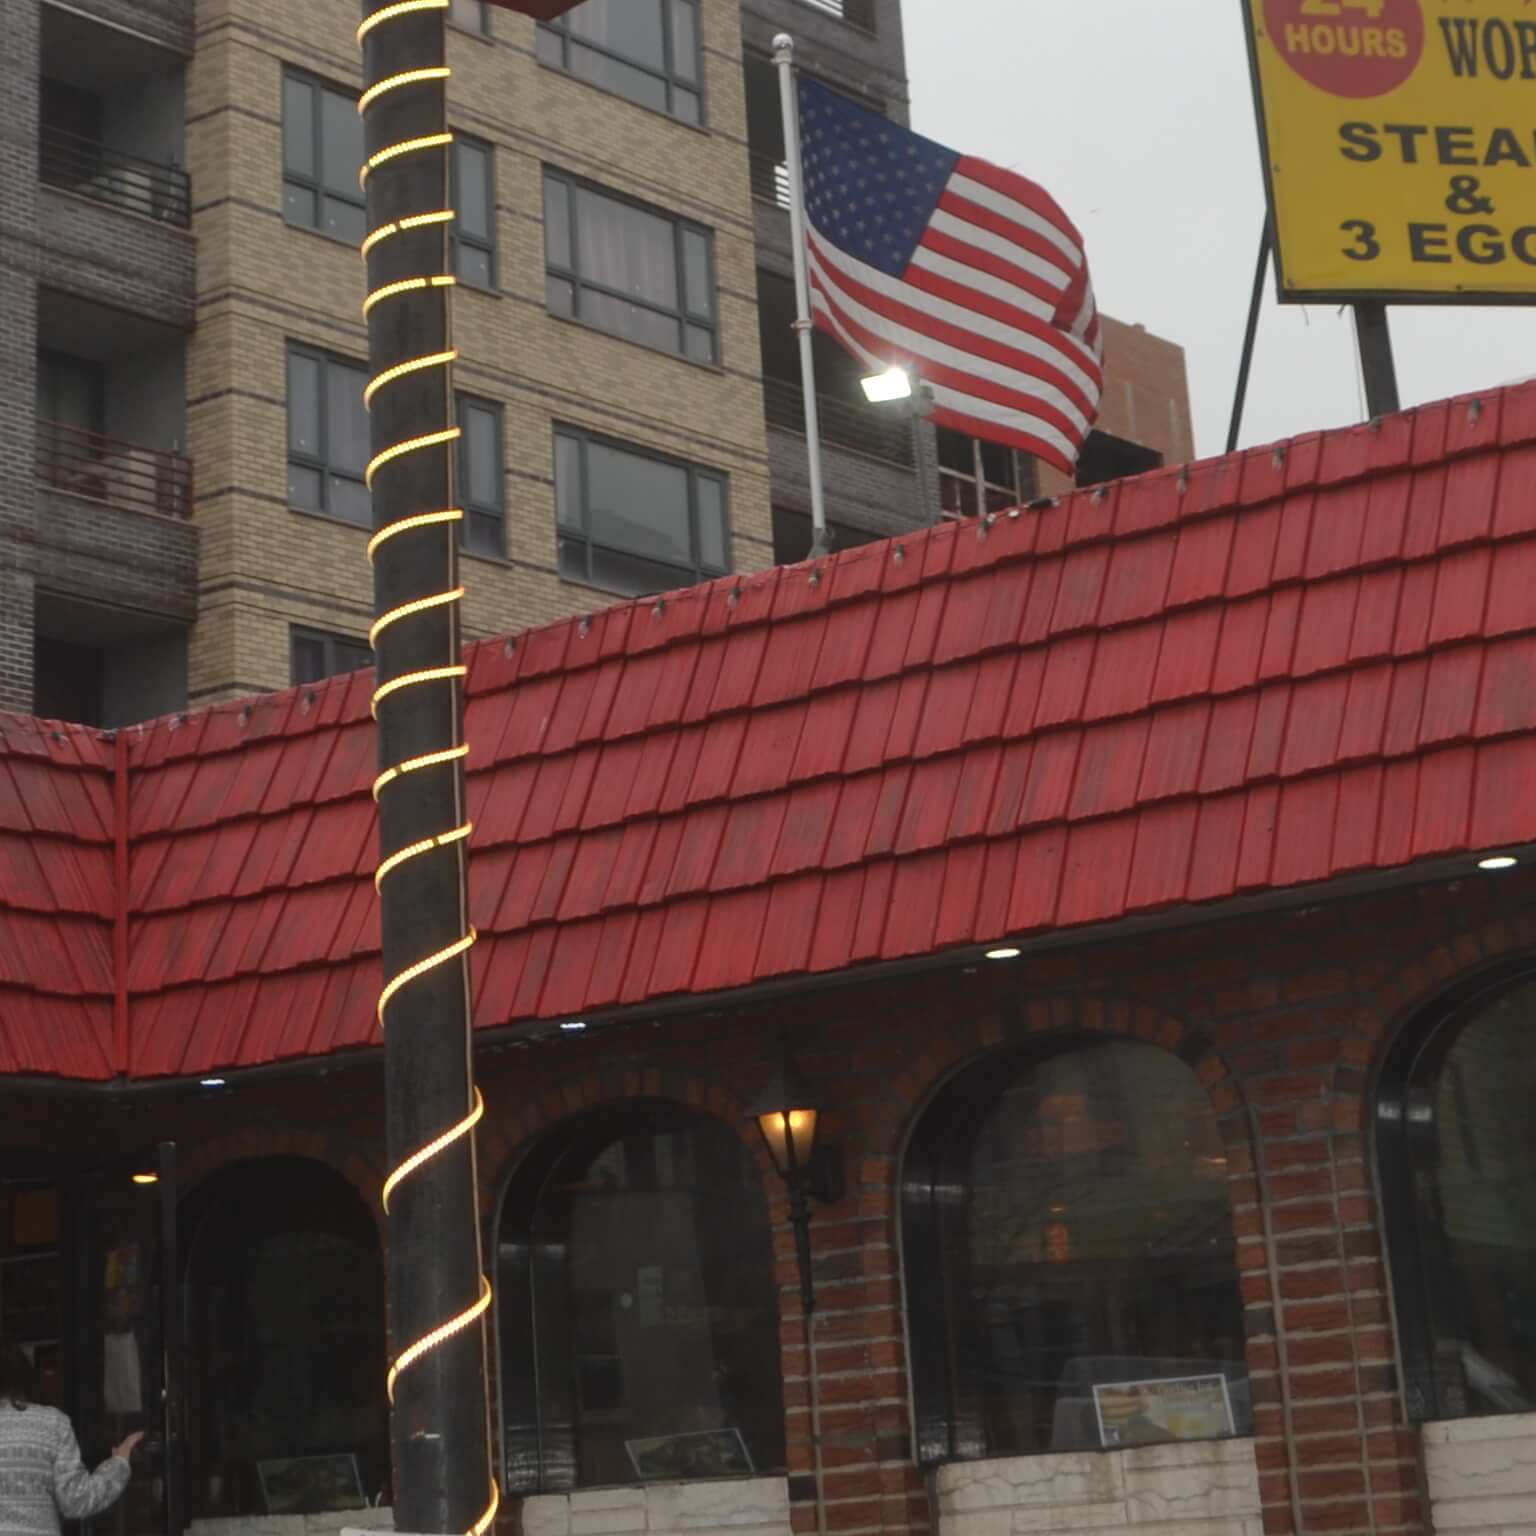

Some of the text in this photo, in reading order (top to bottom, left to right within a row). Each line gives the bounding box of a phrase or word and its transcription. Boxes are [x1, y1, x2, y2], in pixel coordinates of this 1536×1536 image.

[1284, 22, 1407, 59] HOURS
[1444, 174, 1495, 215] &
[1340, 220, 1380, 262] 3
